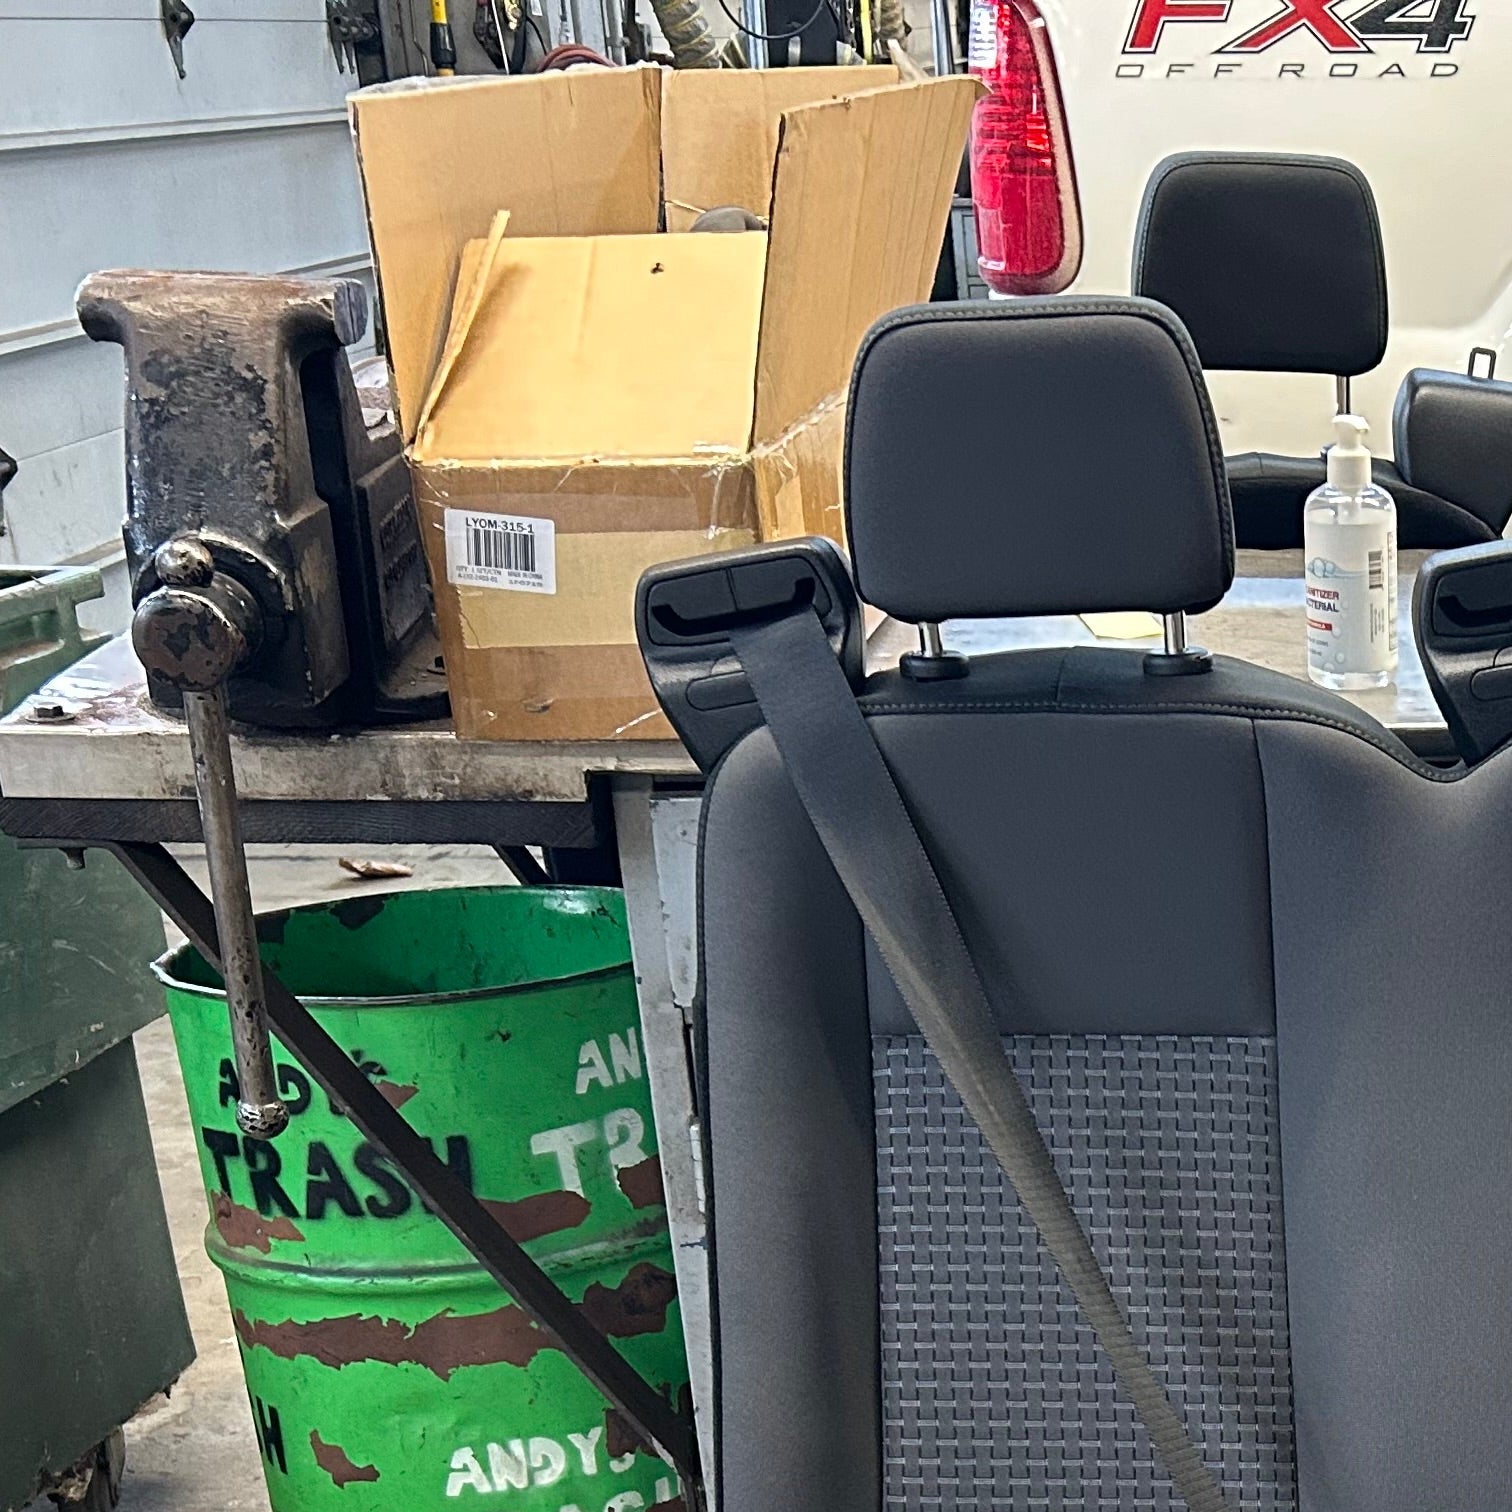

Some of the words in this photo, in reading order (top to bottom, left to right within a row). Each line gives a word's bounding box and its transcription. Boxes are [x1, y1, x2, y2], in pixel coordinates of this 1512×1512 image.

[1115, 63, 1242, 78] OFF
[1278, 63, 1459, 78] ROAD
[465, 517, 535, 534] LYOM-315-1
